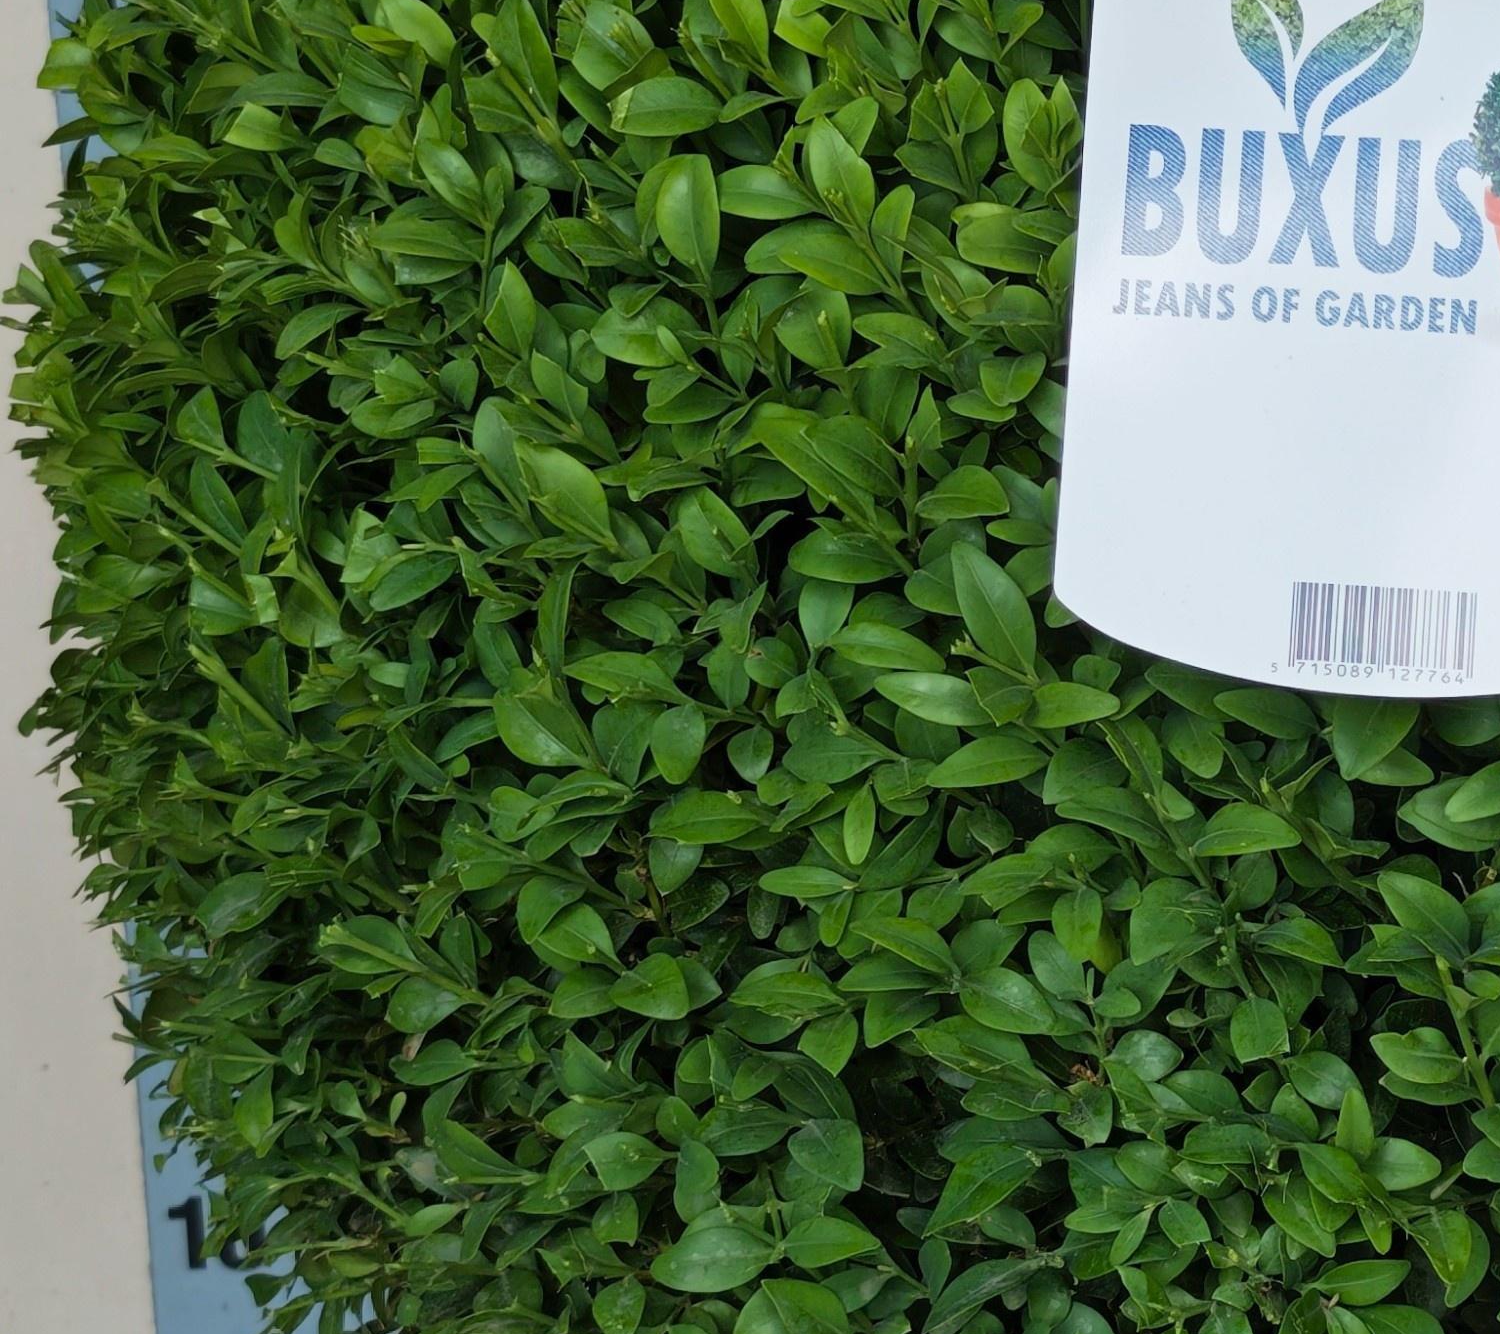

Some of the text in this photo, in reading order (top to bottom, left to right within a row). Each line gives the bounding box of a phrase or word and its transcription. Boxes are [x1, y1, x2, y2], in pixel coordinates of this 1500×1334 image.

[1120, 122, 1485, 279] BUXUS
[1112, 277, 1478, 335] JEANS OF GARDEN
[1270, 661, 1465, 685] 5 715089 127764
